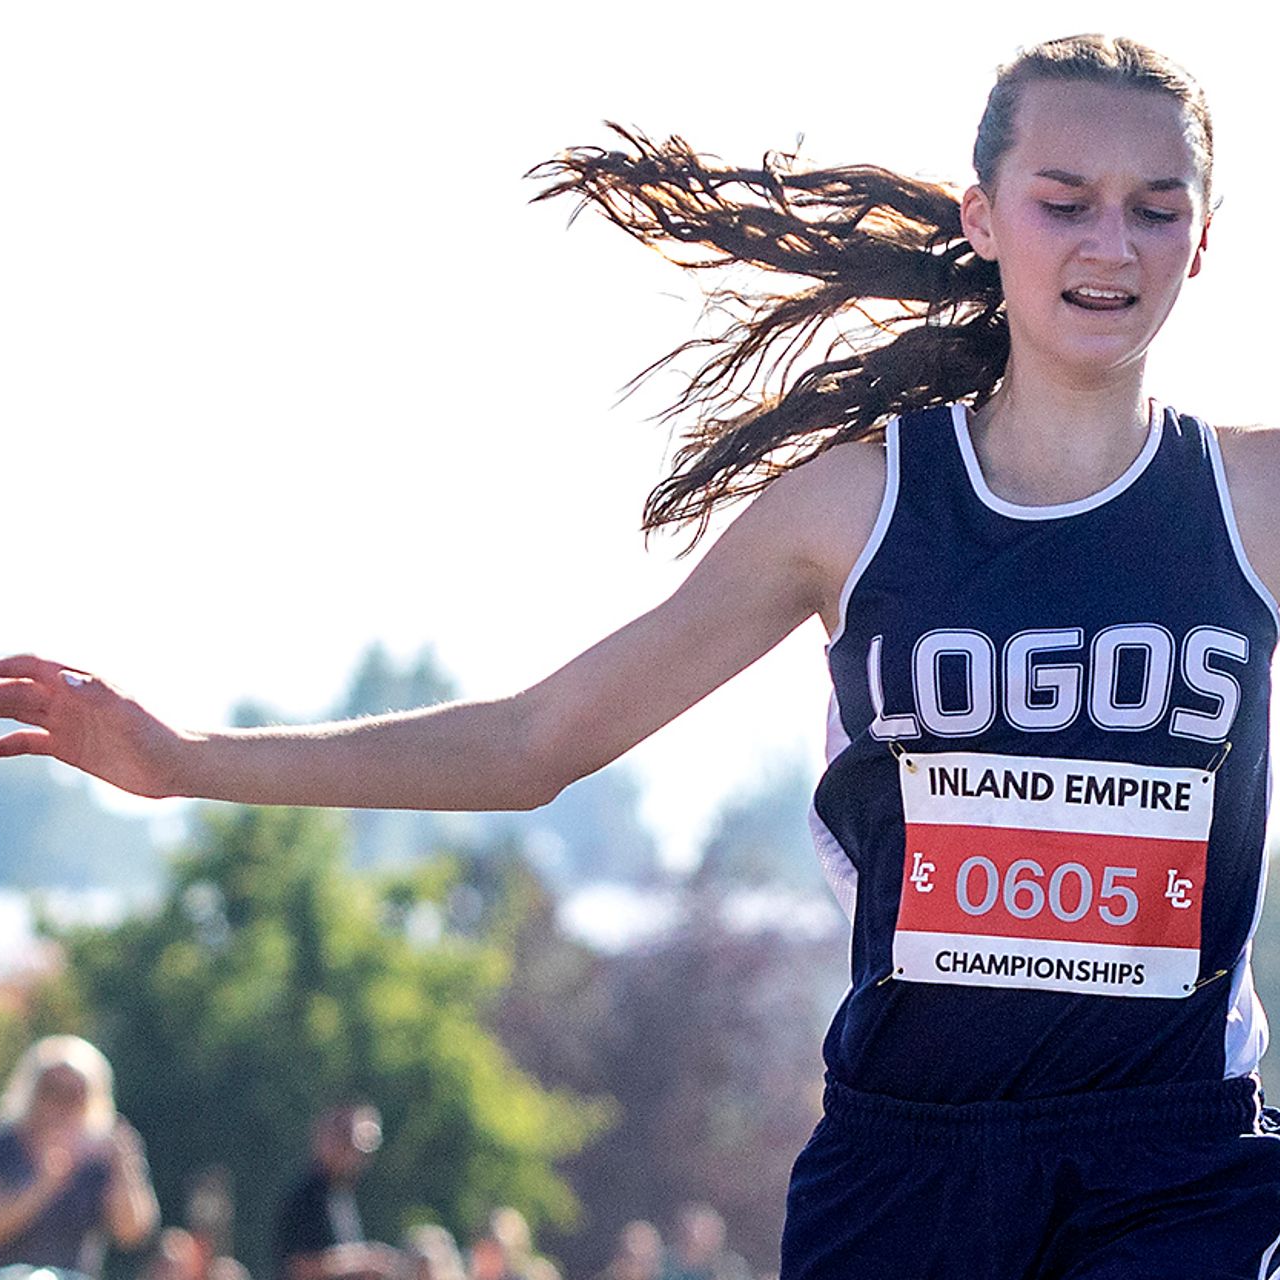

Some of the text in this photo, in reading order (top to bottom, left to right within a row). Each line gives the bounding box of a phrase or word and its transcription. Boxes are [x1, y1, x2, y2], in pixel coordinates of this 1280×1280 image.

[867, 622, 1249, 742] LOGOS
[929, 767, 1191, 811] INLAND EMPIRE
[955, 856, 1139, 926] 0605
[934, 951, 1145, 985] CHAMPIONSHIPS
